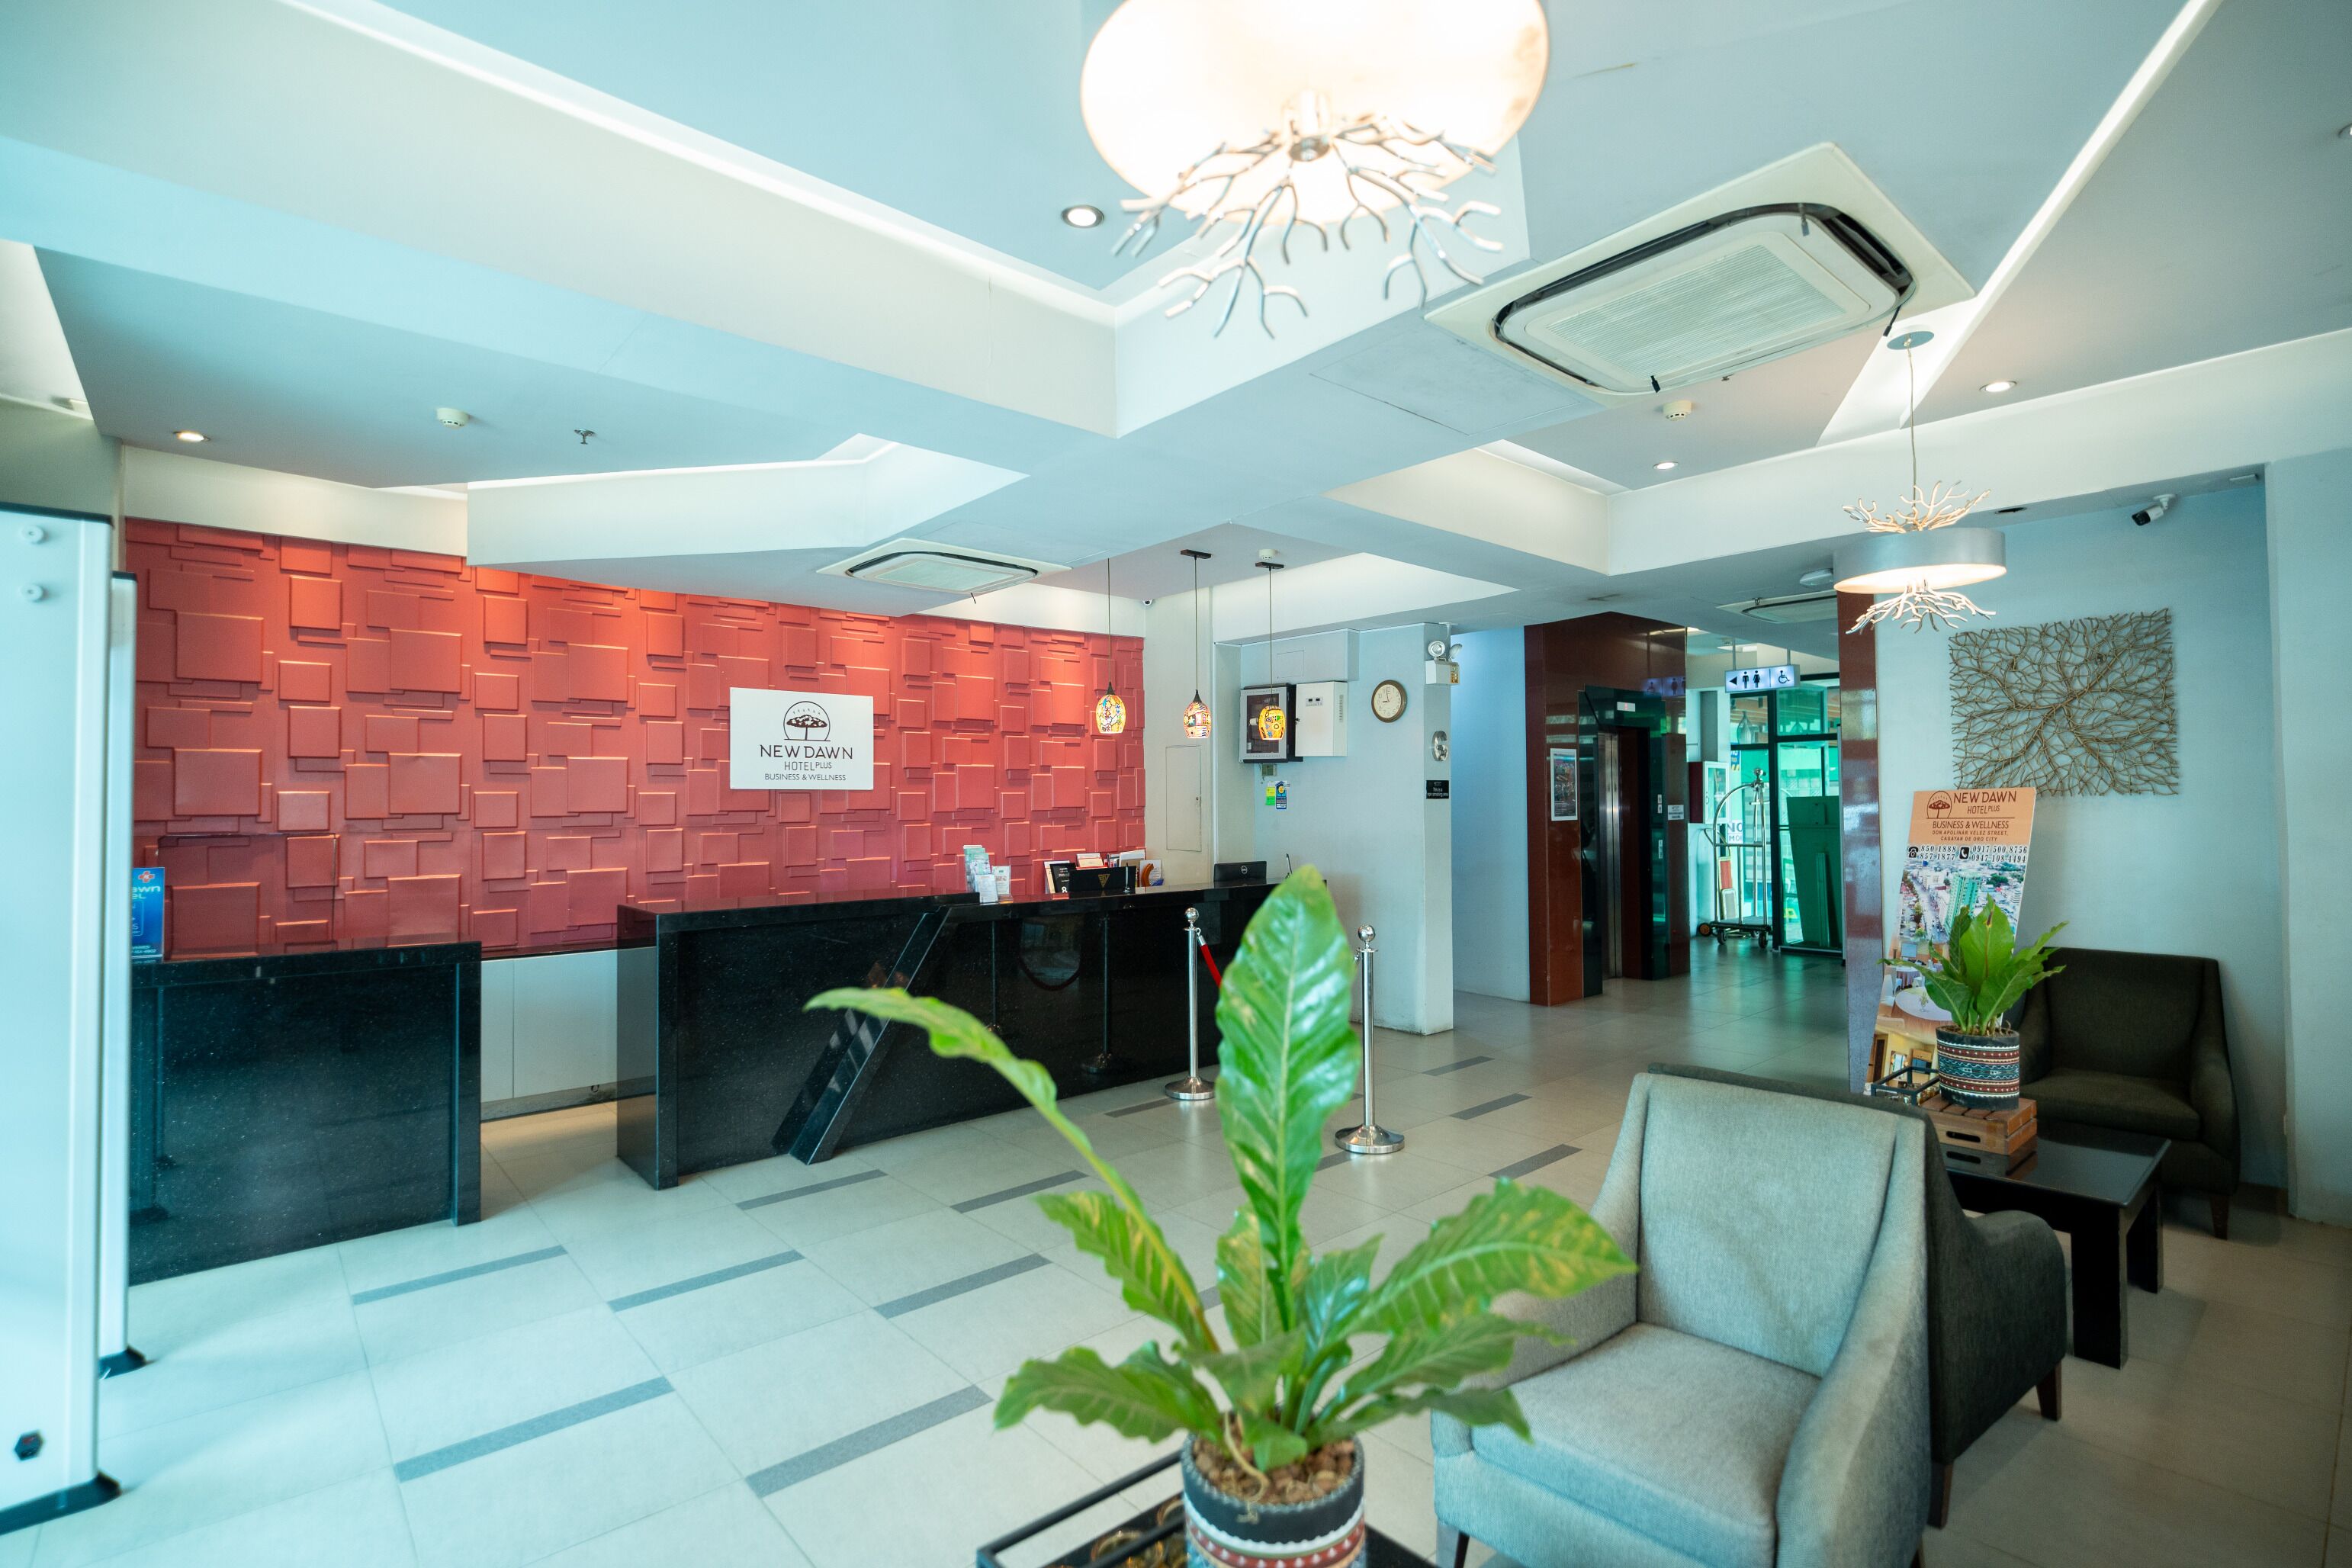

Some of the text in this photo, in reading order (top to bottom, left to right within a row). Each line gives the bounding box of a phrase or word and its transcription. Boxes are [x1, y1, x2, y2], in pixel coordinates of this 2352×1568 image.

[760, 744, 853, 760] NEW DAWN
[784, 761, 832, 771] HOTEL PLUS
[1953, 791, 2017, 804] NEW DAWN
[1967, 805, 1988, 815] HOTEL
[1932, 821, 1964, 829] BUSINESS
[1971, 821, 2010, 829] WELLNESS
[2009, 846, 2027, 854] 8756
[2007, 855, 2026, 863] 4494
